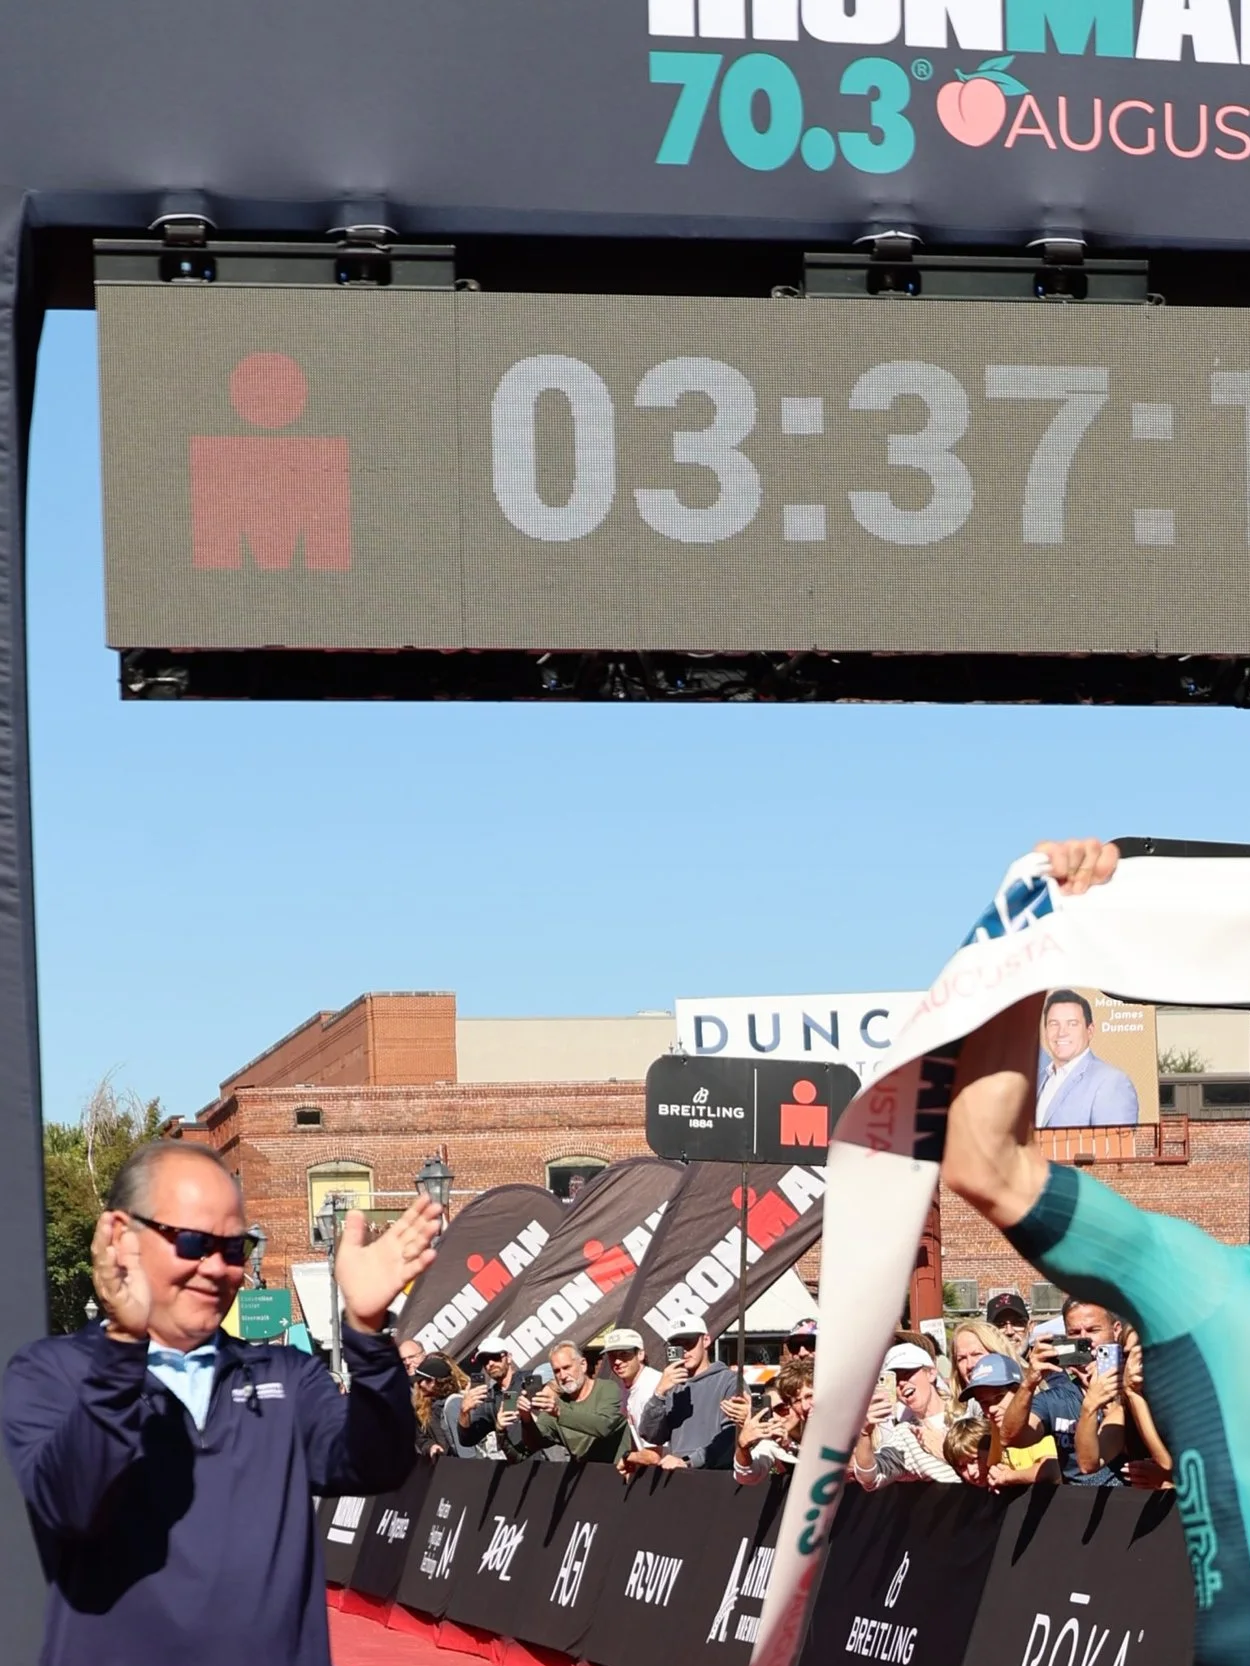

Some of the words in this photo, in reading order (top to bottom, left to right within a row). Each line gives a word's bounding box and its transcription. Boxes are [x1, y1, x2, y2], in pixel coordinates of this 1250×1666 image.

[648, 50, 916, 174] 70.3
[1102, 1021, 1144, 1032] Duncan
[1110, 1009, 1144, 1020] James
[658, 1103, 745, 1119] BREITLING
[689, 1119, 713, 1129] 1884
[642, 1165, 829, 1343] IRONMA
[502, 1200, 669, 1369] IRONMA
[624, 1549, 684, 1607] ROUVY
[845, 1616, 918, 1666] BREITLING
